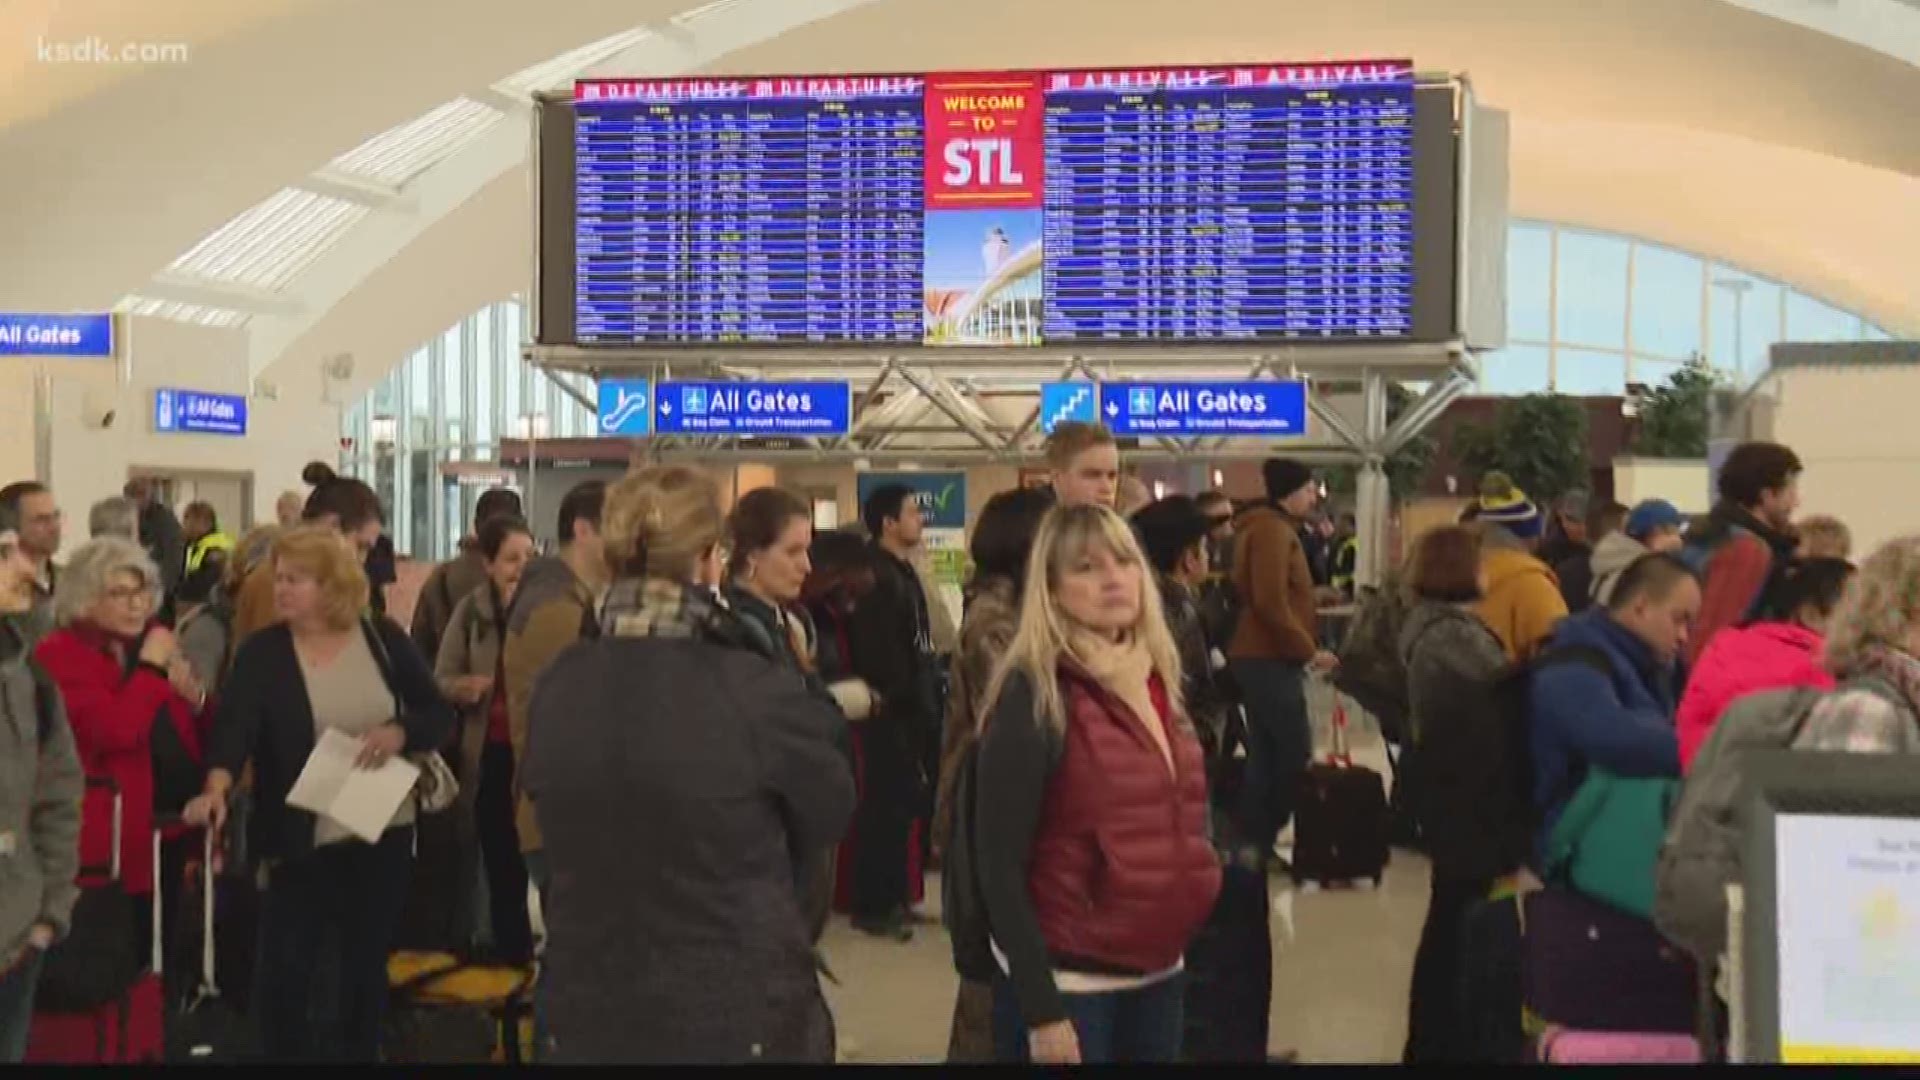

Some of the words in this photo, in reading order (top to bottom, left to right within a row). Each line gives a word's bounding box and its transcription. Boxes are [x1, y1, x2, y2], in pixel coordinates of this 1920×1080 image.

[944, 95, 1025, 111] WELCOME
[973, 116, 995, 131] TO
[943, 138, 1023, 186] STL
[0, 326, 21, 343] All
[26, 325, 82, 344] Gates
[710, 389, 740, 412] All
[747, 389, 812, 412] Gates
[1158, 390, 1190, 412] All
[1197, 390, 1267, 413] Gates
